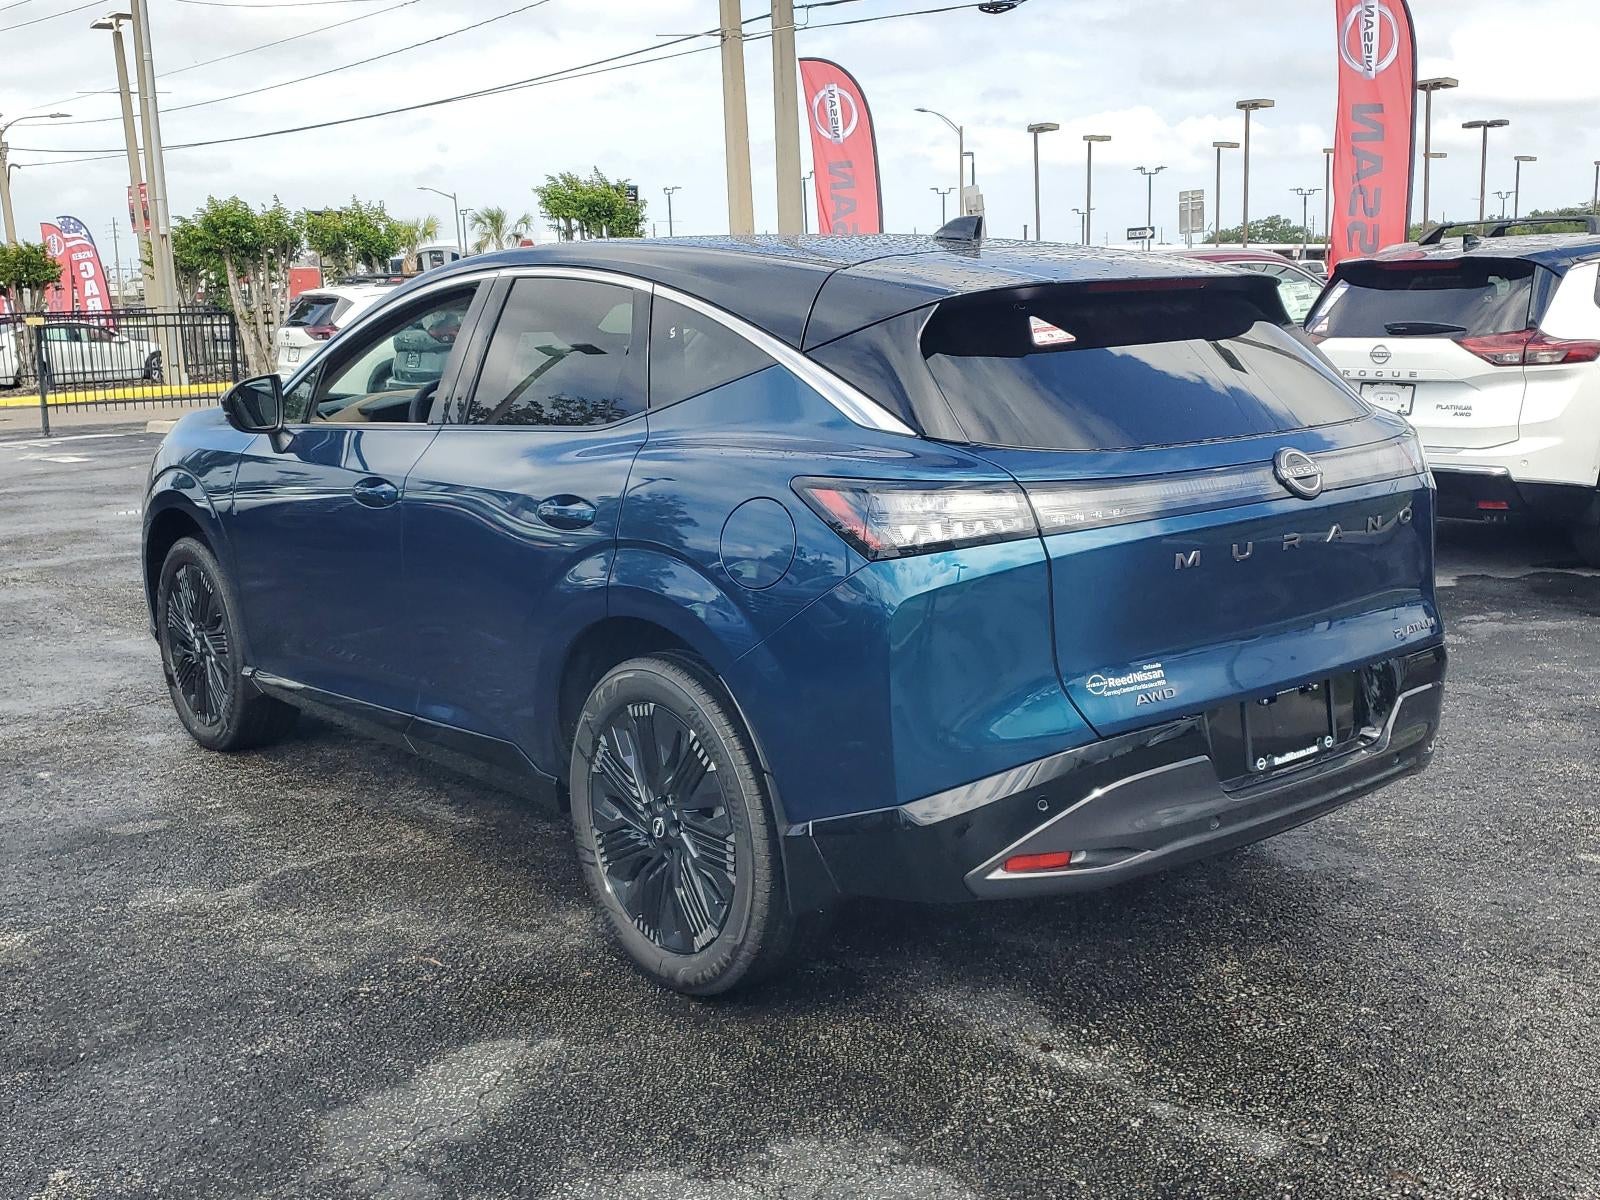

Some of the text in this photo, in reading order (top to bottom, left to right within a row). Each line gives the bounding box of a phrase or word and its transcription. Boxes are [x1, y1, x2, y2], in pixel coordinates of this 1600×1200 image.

[1342, 369, 1417, 378] ROGUE
[1435, 403, 1473, 411] PLATINUM
[1281, 464, 1322, 477] NISSAN
[1174, 506, 1413, 570] MURANO
[1142, 662, 1162, 671] Orlando
[1086, 680, 1108, 688] NISSAN
[1136, 687, 1176, 707] AWD
